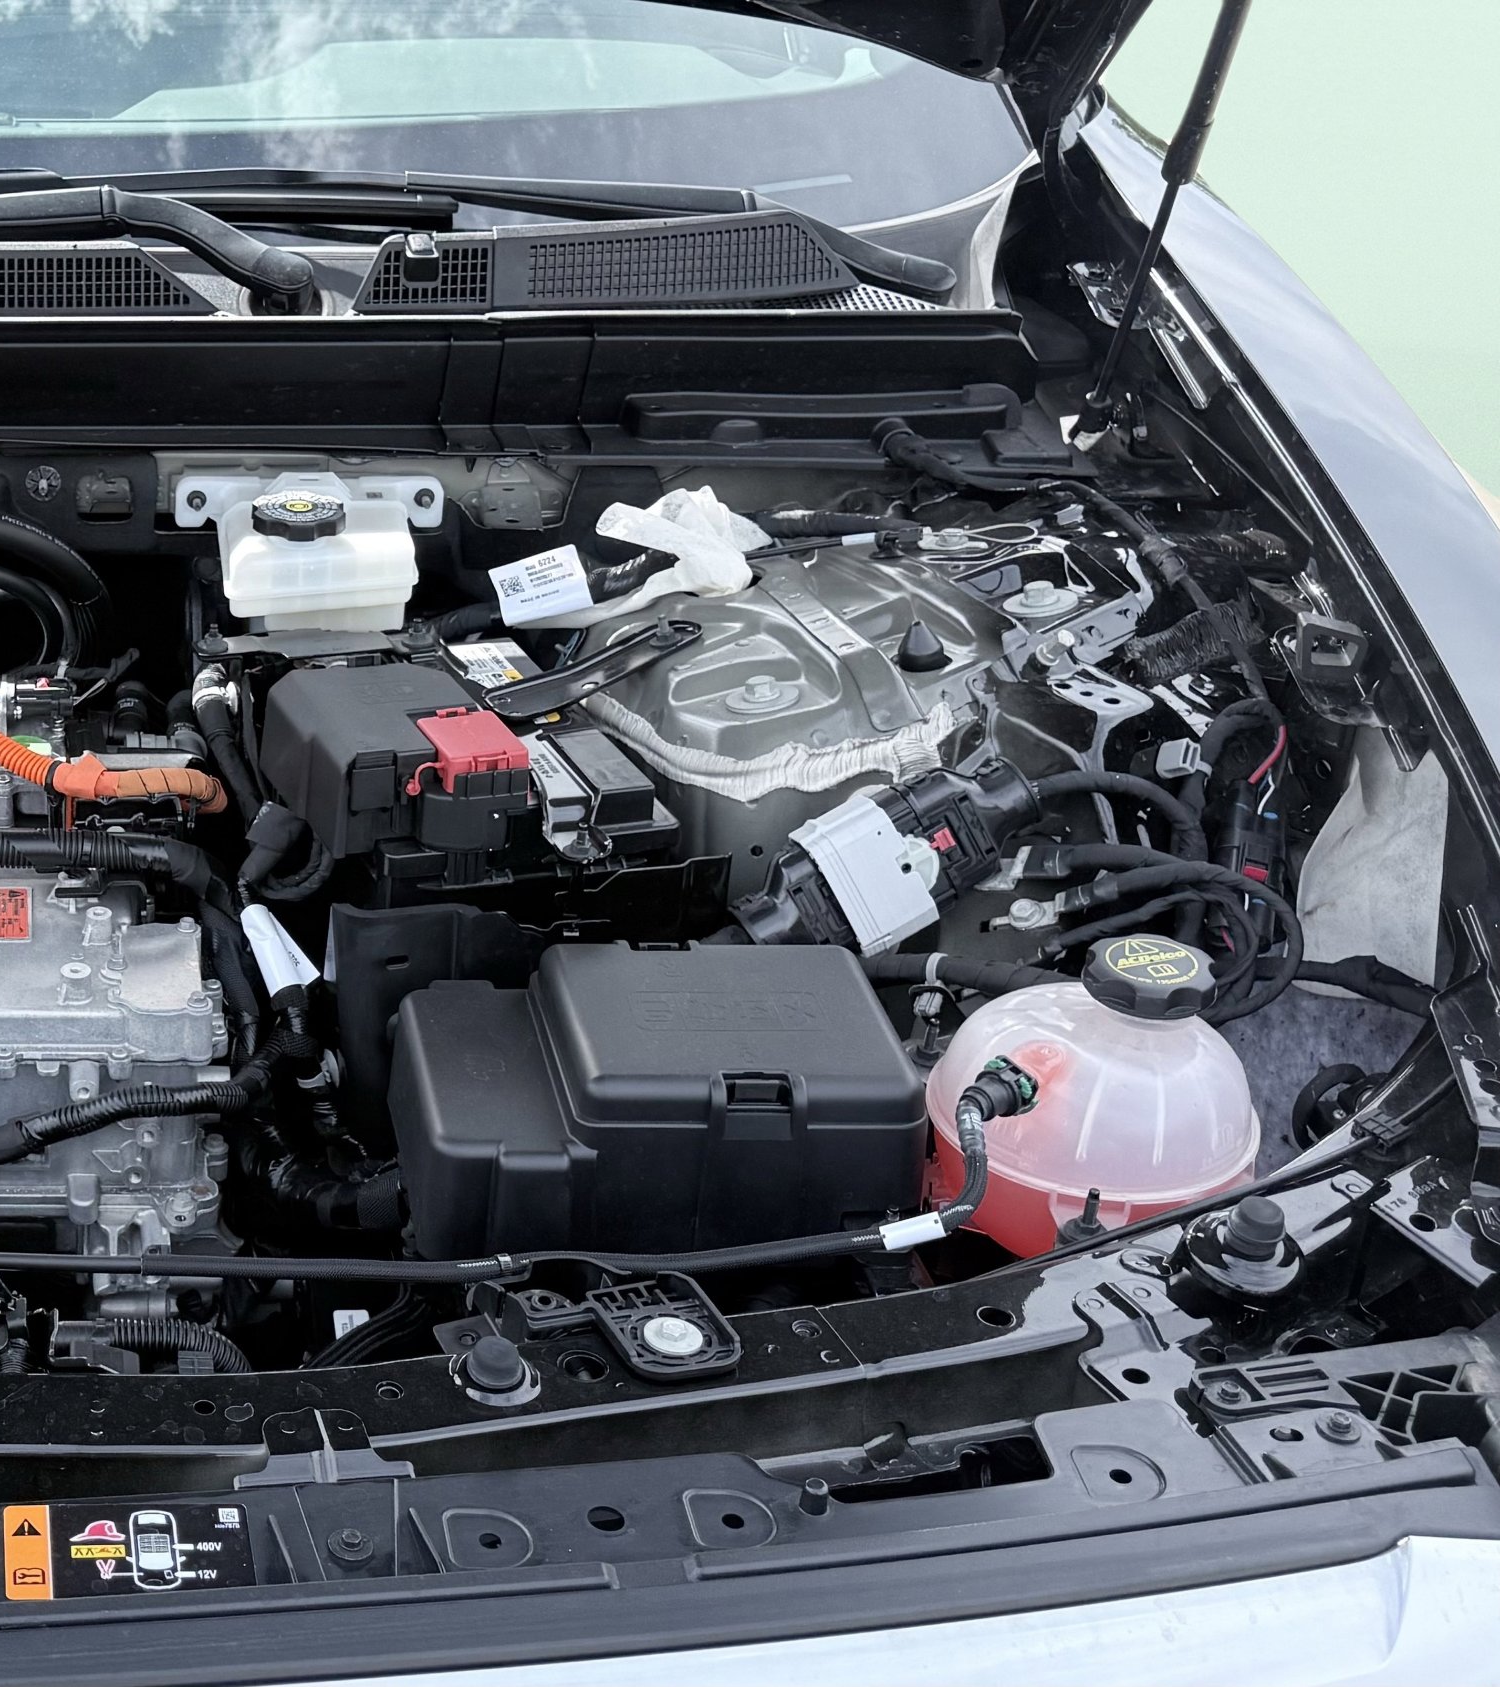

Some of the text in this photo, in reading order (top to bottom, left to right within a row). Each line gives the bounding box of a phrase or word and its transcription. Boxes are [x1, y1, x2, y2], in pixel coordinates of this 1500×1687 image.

[538, 556, 556, 567] 6224
[1117, 951, 1186, 967] ACDelco
[196, 1541, 222, 1552] 400V
[197, 1569, 218, 1579] 12V
